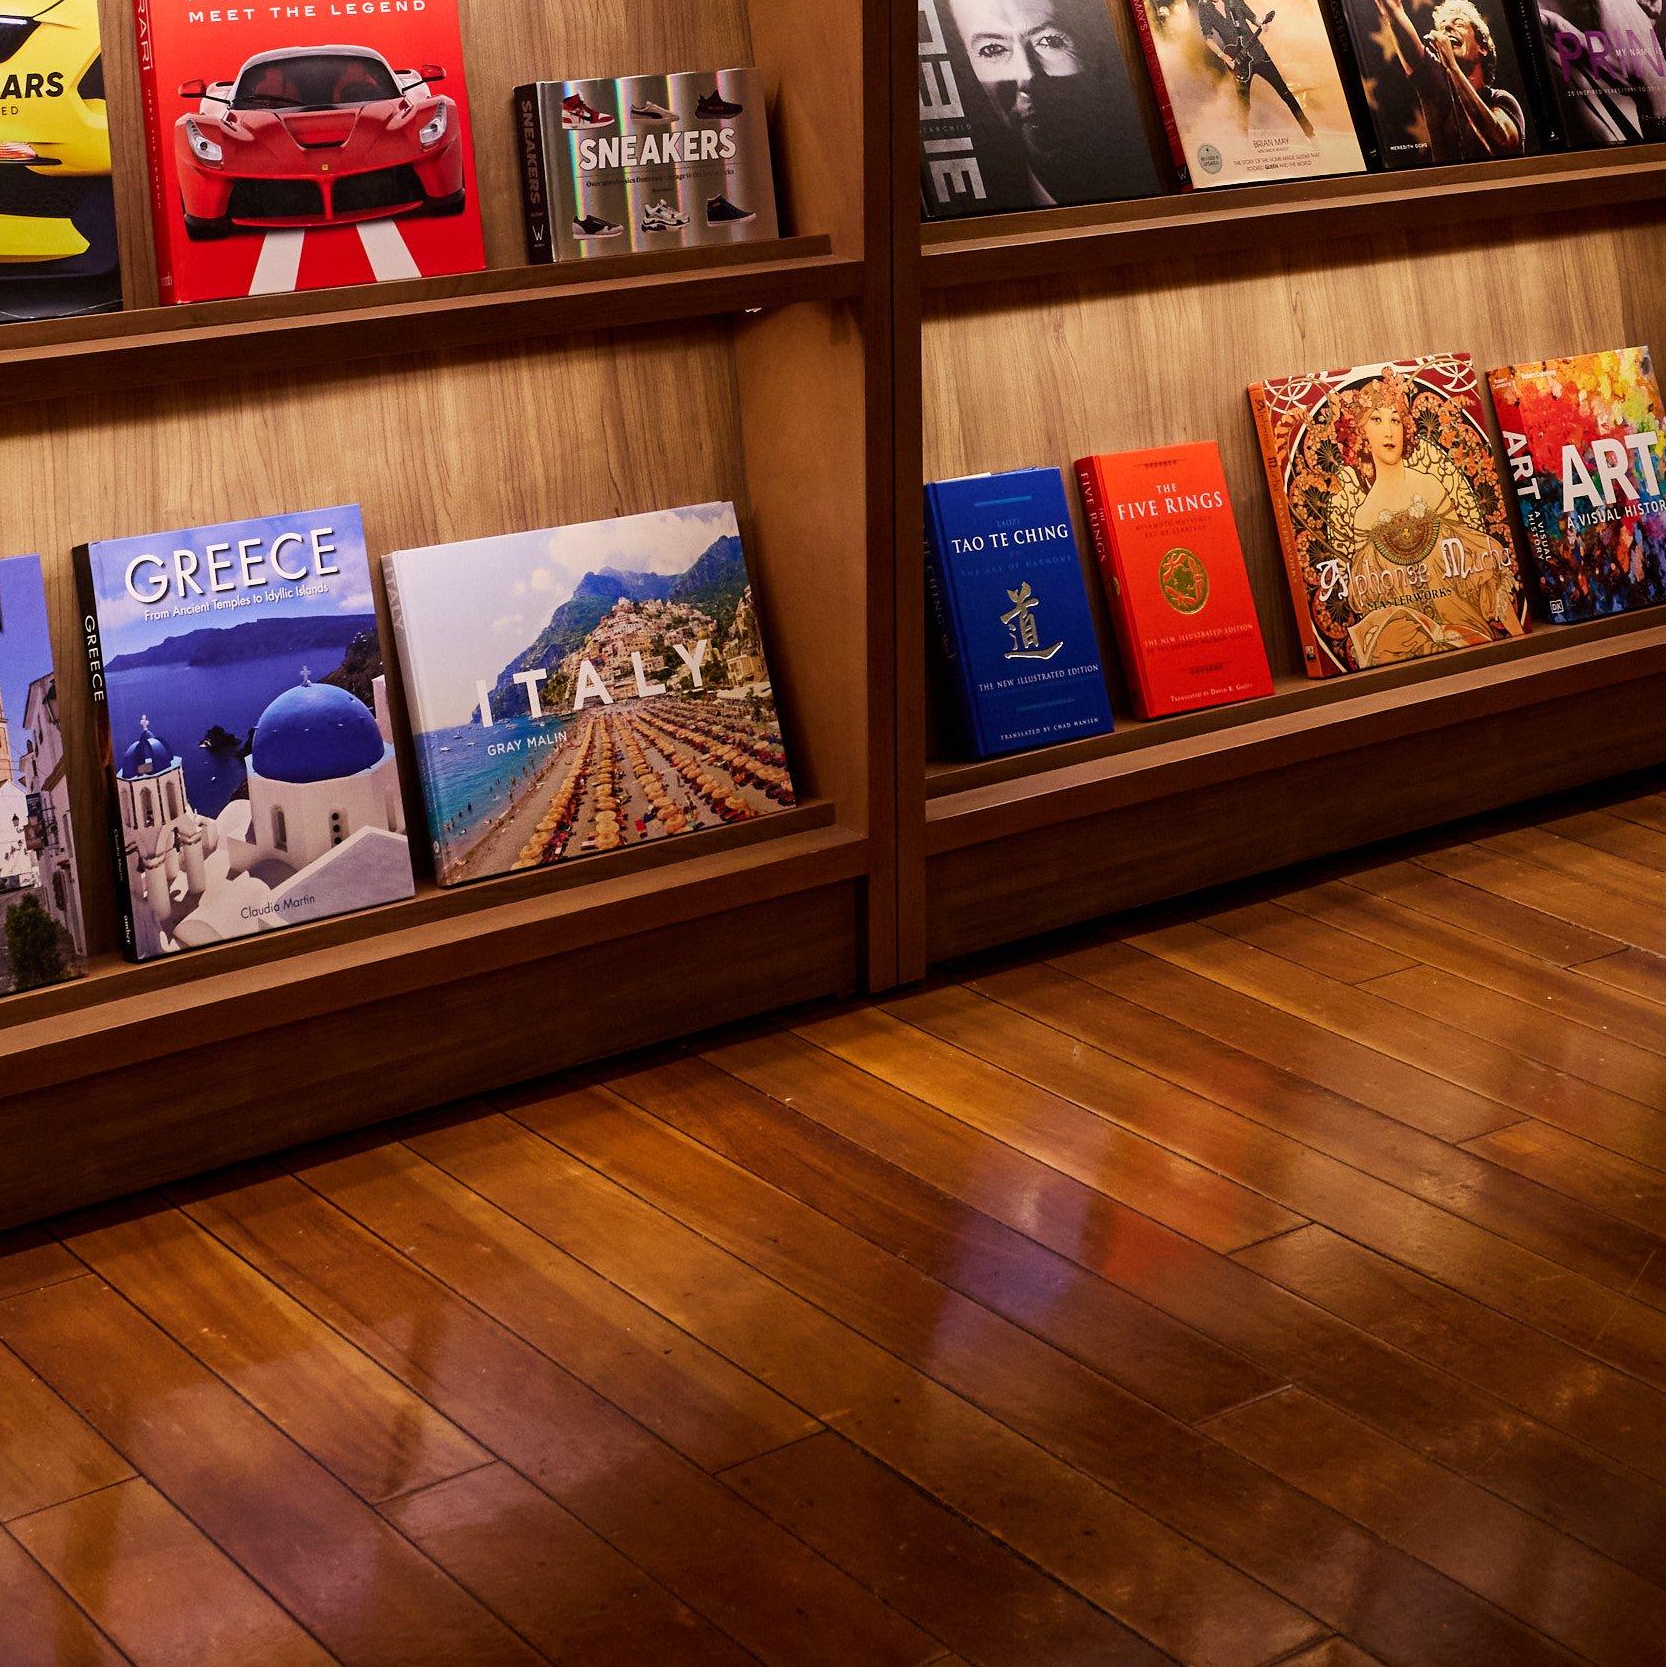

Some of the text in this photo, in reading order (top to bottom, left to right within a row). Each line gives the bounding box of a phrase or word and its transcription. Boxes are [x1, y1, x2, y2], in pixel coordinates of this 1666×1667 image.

[188, 0, 427, 23] MEET THE LEGEND
[579, 127, 736, 171] SNEAKERS
[1503, 430, 1541, 500] ART
[1561, 431, 1661, 513] ART
[1080, 472, 1095, 504] FIVE
[1156, 483, 1177, 494] THE
[1117, 491, 1224, 521] FIVE RINGS
[1566, 516, 1574, 529] A
[1579, 510, 1622, 527] VISUAL
[951, 523, 1069, 554] TAO TE CHING
[1527, 513, 1545, 561] HISTORY
[1537, 522, 1552, 561] VISUAL
[124, 527, 340, 604] GREECE
[1316, 537, 1512, 608] Alphonse Mucha
[144, 582, 329, 622] From Ancient Temples to Idyllic Islands
[1366, 585, 1453, 612] MASTERWORKS
[1550, 601, 1563, 613] DK
[1000, 581, 1064, 661] 道
[84, 614, 104, 702] GREECE
[471, 638, 708, 729] ITALY
[978, 664, 1099, 692] THE NEW ILLUSTRATED EDITION
[487, 731, 568, 757] GRAY MALIN
[241, 893, 316, 920] Claudia Martin
